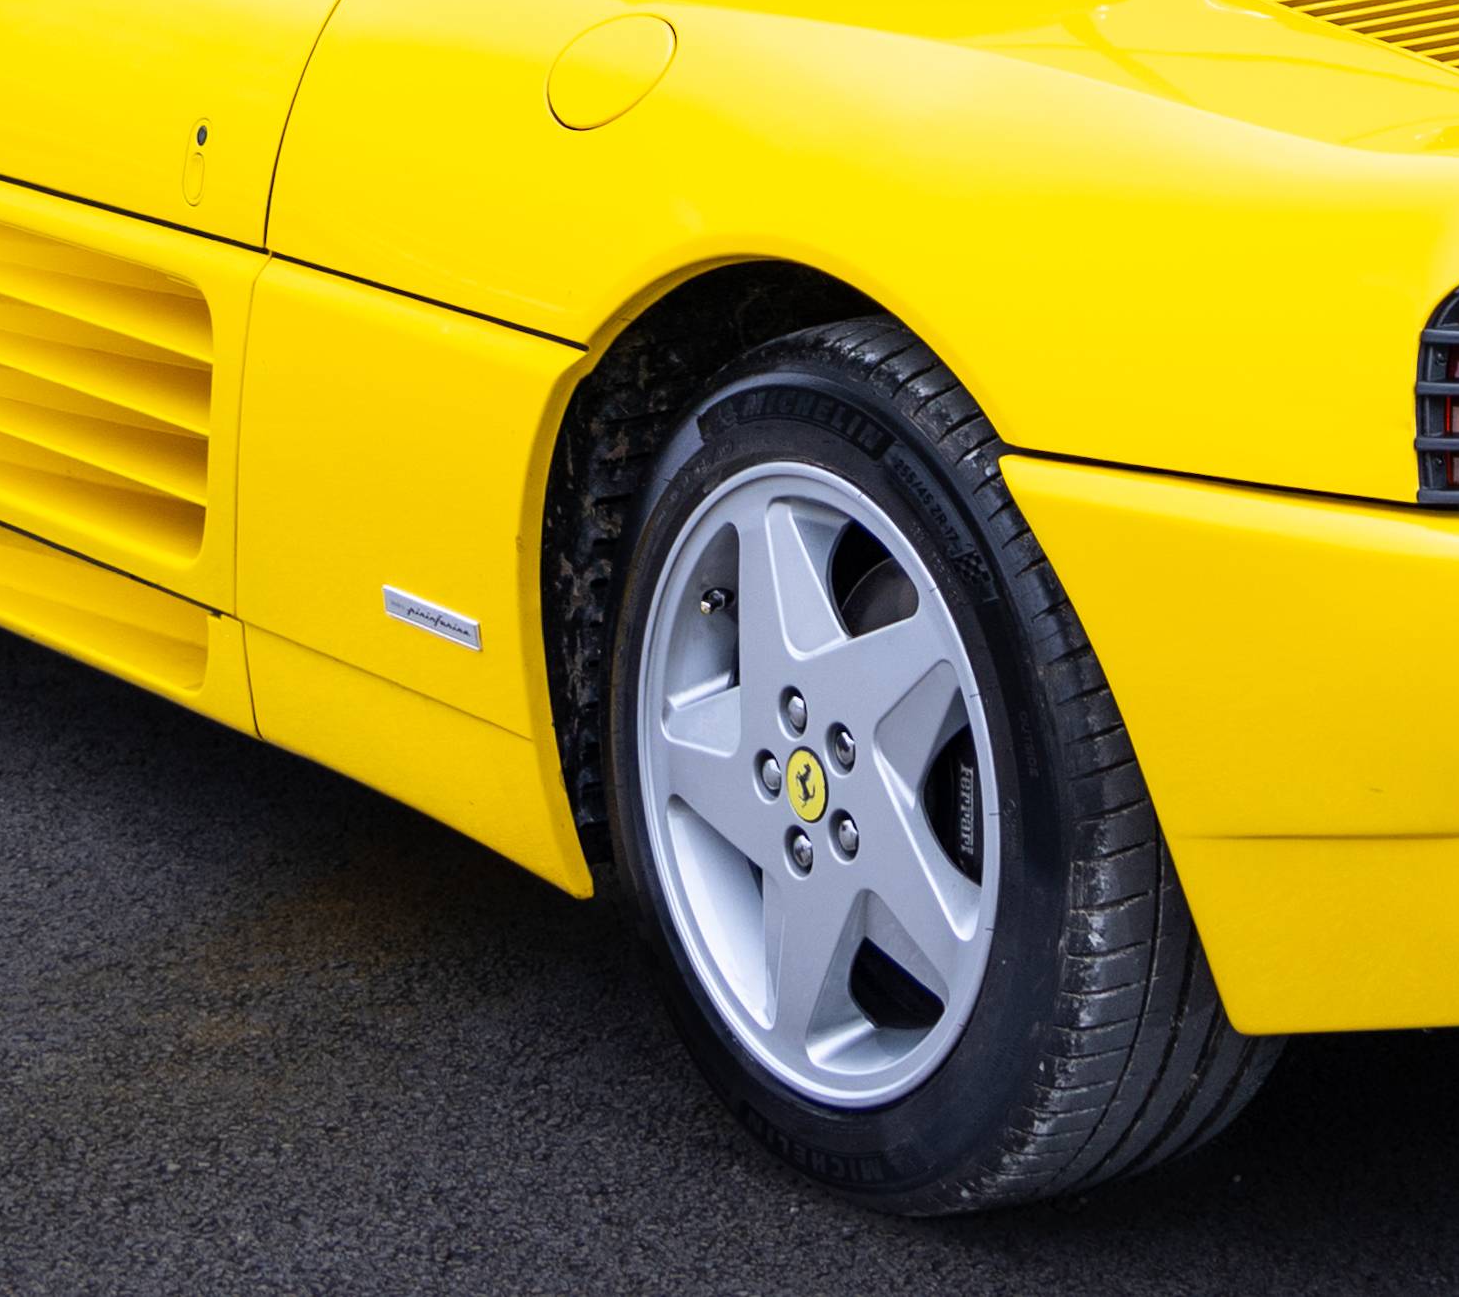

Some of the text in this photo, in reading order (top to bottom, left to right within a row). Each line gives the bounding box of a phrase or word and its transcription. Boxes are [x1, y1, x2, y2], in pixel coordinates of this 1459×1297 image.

[741, 390, 885, 454] MICHELIN
[891, 458, 934, 506] 255/45
[746, 1109, 885, 1182] MICHELIN
